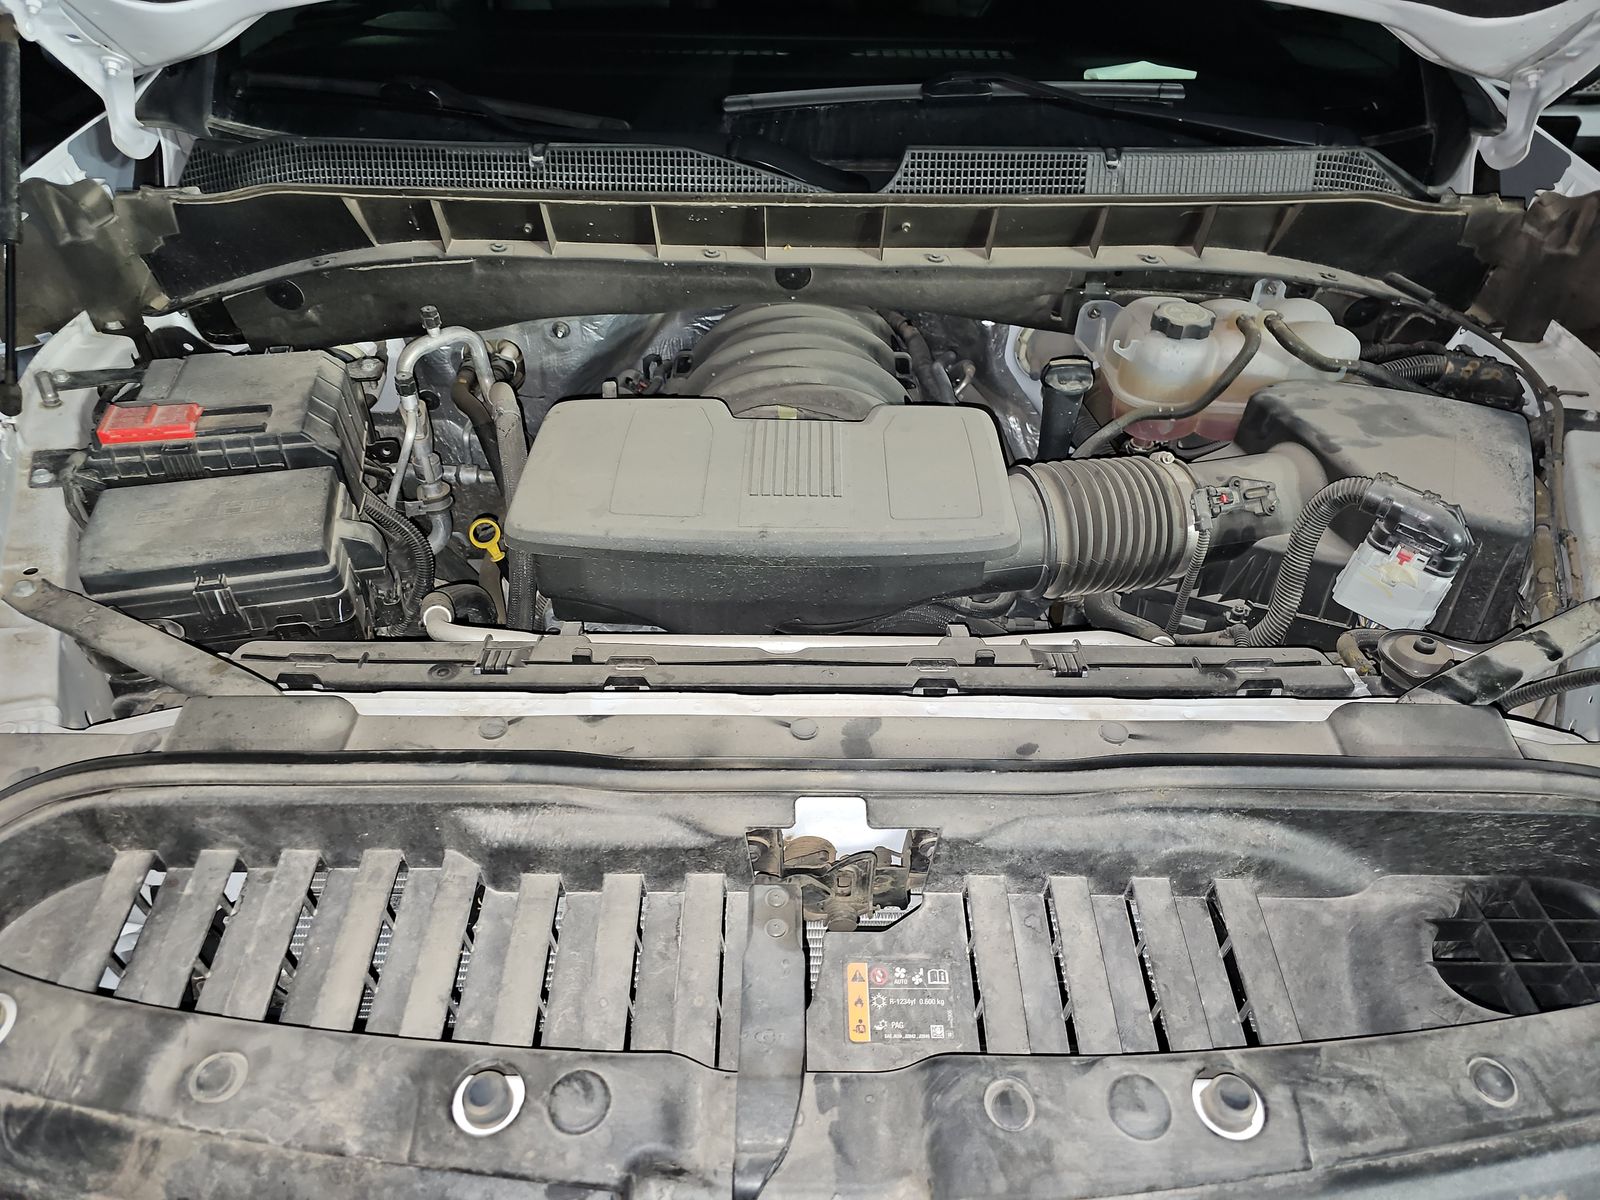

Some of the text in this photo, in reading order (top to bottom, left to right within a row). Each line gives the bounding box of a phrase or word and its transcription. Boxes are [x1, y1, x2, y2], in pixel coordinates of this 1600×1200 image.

[889, 998, 916, 1007] R-1234yf
[936, 998, 945, 1007] kg
[891, 1021, 905, 1029] PAG
